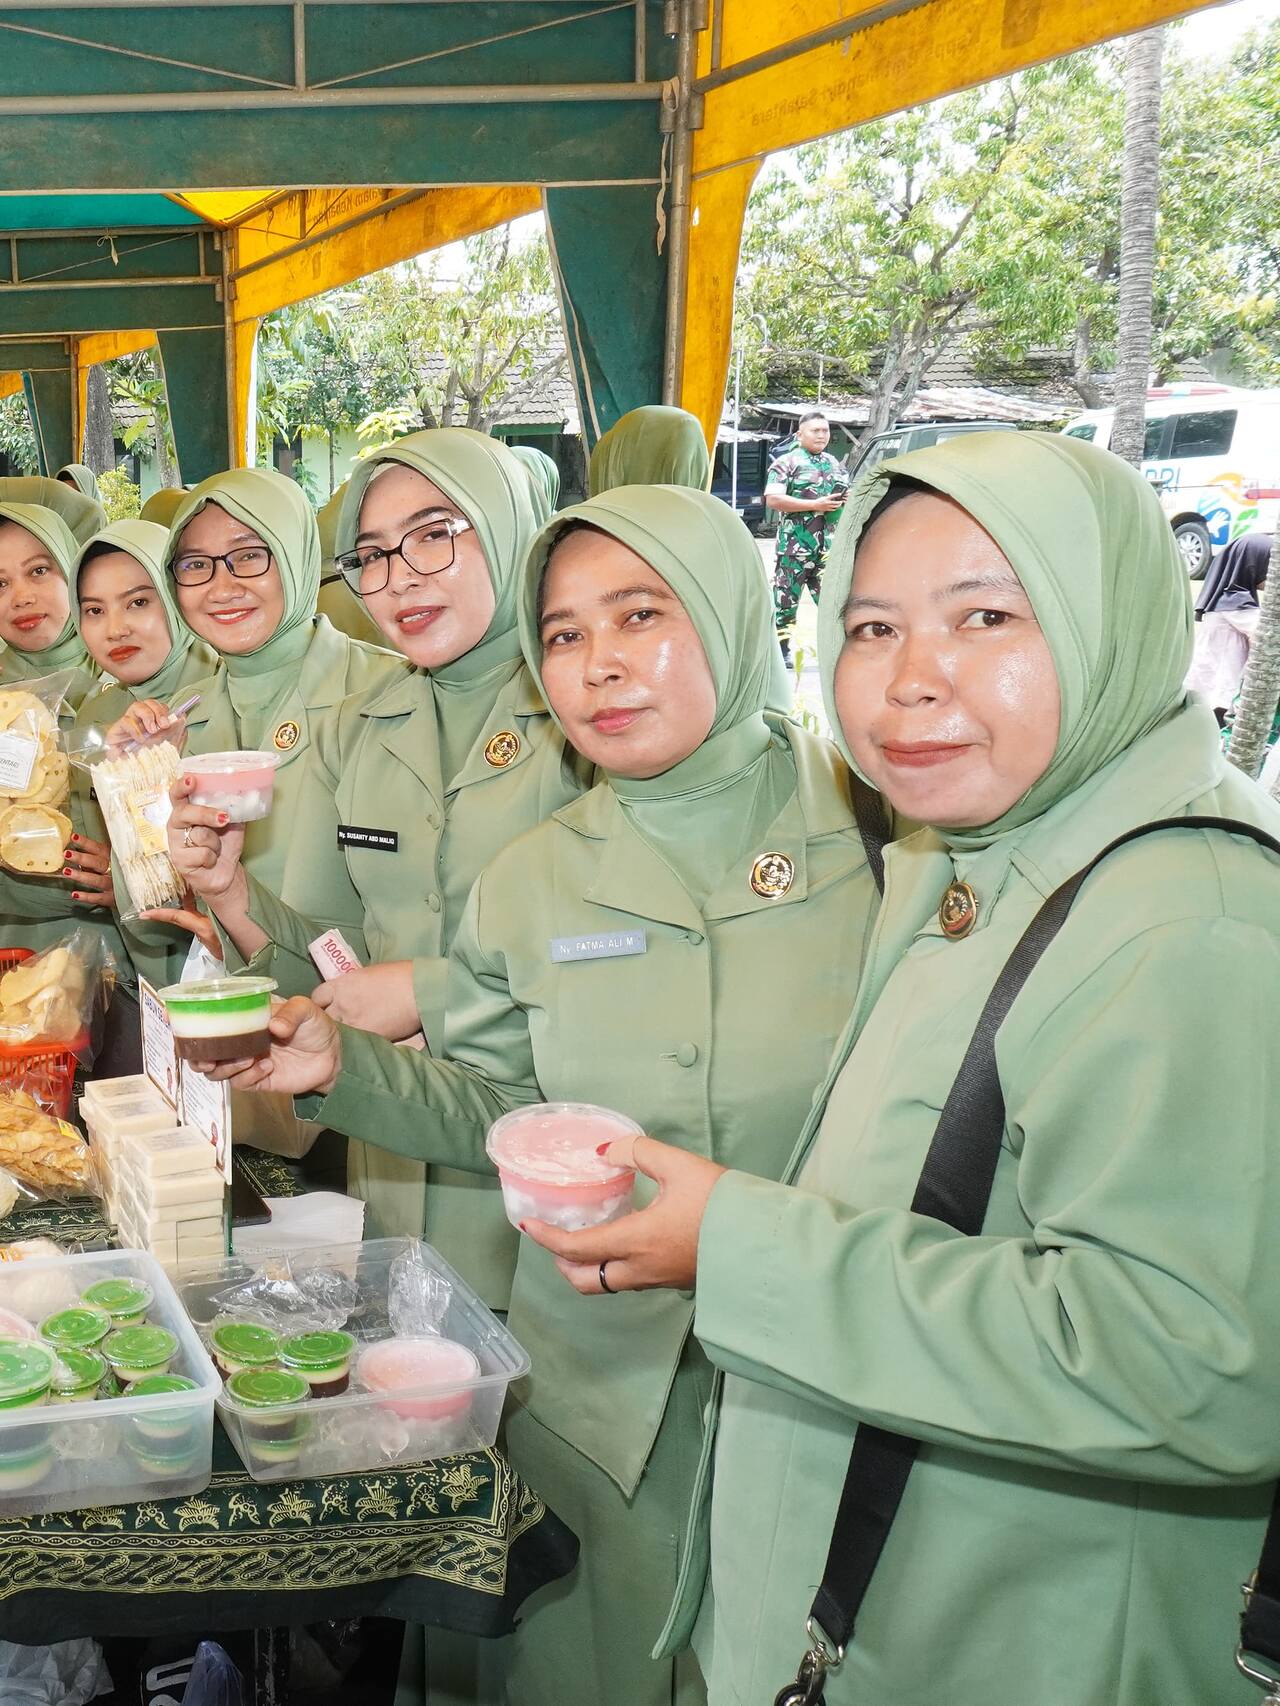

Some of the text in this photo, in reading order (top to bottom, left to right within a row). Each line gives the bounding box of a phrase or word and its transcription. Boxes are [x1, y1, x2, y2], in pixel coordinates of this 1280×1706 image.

[346, 832, 368, 841] SUSANTY
[576, 940, 605, 952] FATMA
[608, 938, 622, 948] ALI
[626, 936, 634, 946] M
